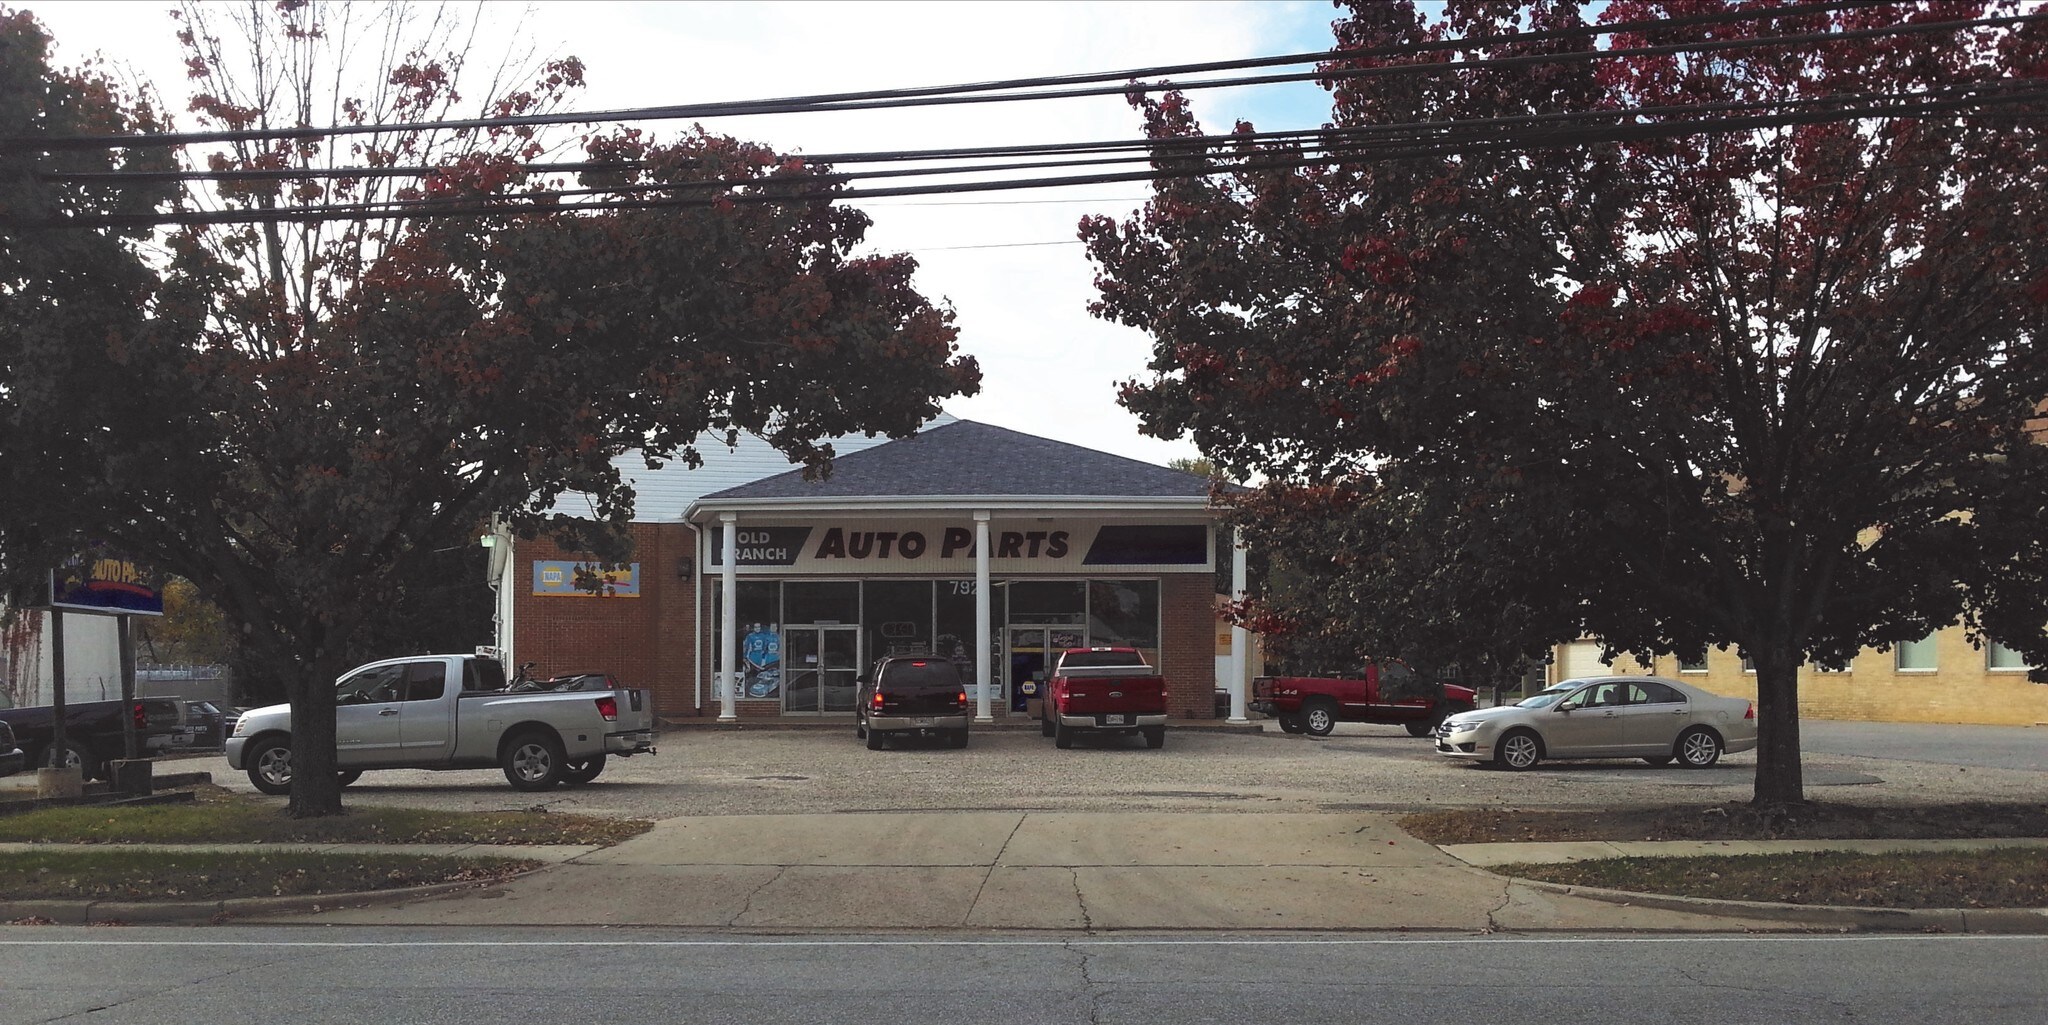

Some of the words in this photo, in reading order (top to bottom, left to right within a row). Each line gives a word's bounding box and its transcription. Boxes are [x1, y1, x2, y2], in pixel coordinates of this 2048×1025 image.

[737, 531, 771, 544] OLD
[814, 527, 927, 559] AUTO
[721, 547, 788, 560] RANCH
[91, 558, 121, 582] AUTO
